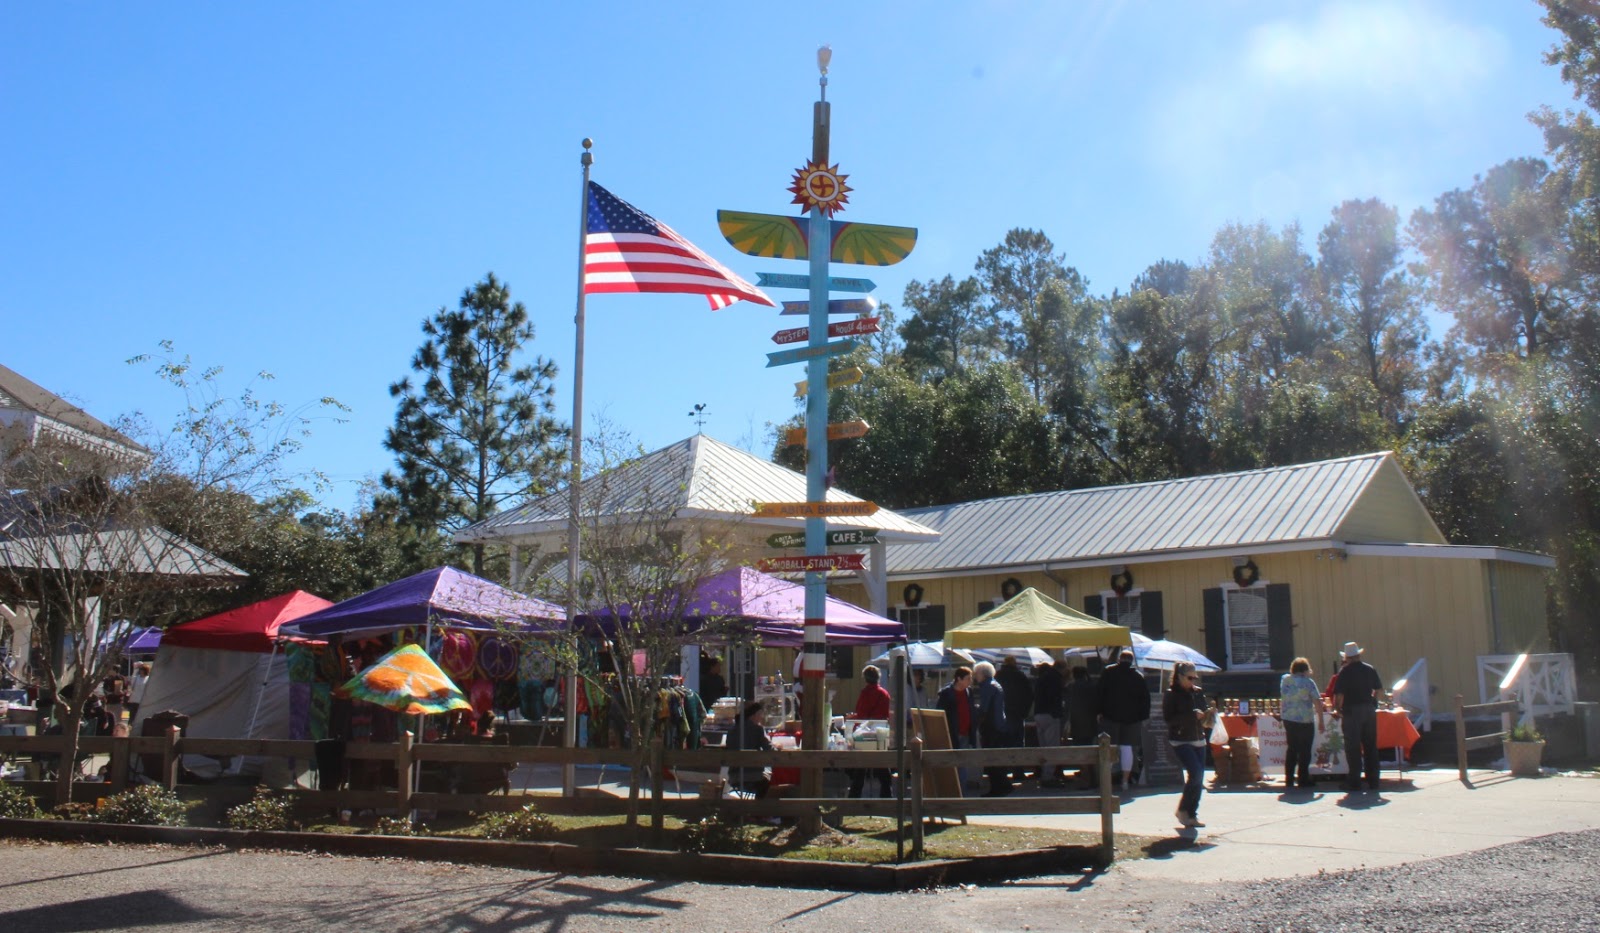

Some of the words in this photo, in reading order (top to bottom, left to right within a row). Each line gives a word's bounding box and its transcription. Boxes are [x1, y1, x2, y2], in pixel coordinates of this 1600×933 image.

[777, 328, 808, 343] MYSTER
[835, 322, 854, 334] HOUSE
[856, 321, 863, 333] 4
[780, 504, 814, 515] ABITA
[817, 503, 871, 515] BREWING
[832, 532, 857, 543] CAFE
[857, 530, 864, 544] 3
[809, 557, 834, 569] STAND
